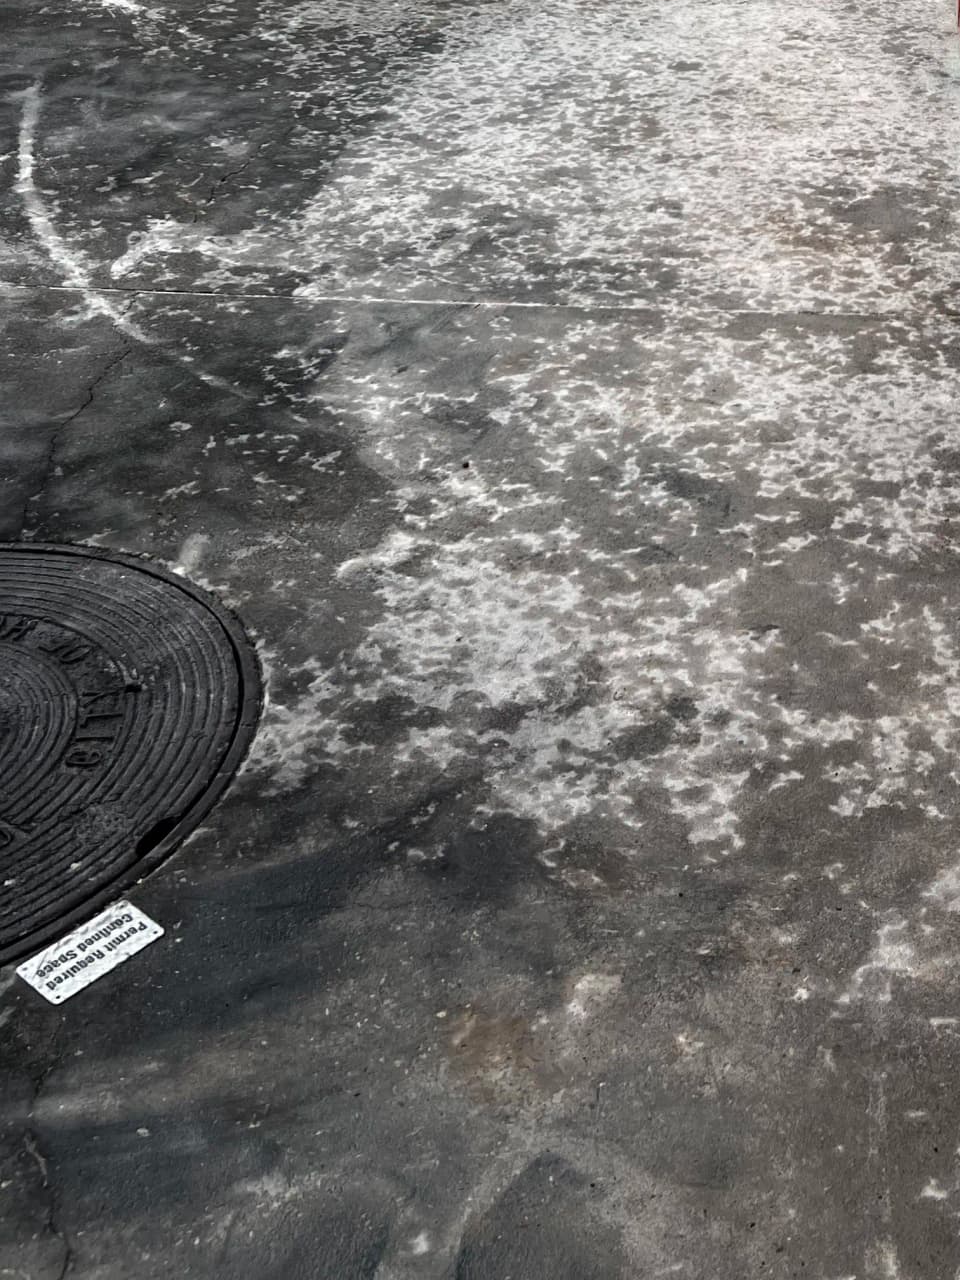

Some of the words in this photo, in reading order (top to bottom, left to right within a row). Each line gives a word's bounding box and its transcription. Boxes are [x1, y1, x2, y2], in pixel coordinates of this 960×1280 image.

[77, 913, 133, 952] Confined
[104, 922, 148, 952] Permit
[36, 950, 78, 978] Space
[46, 950, 105, 990] Required
